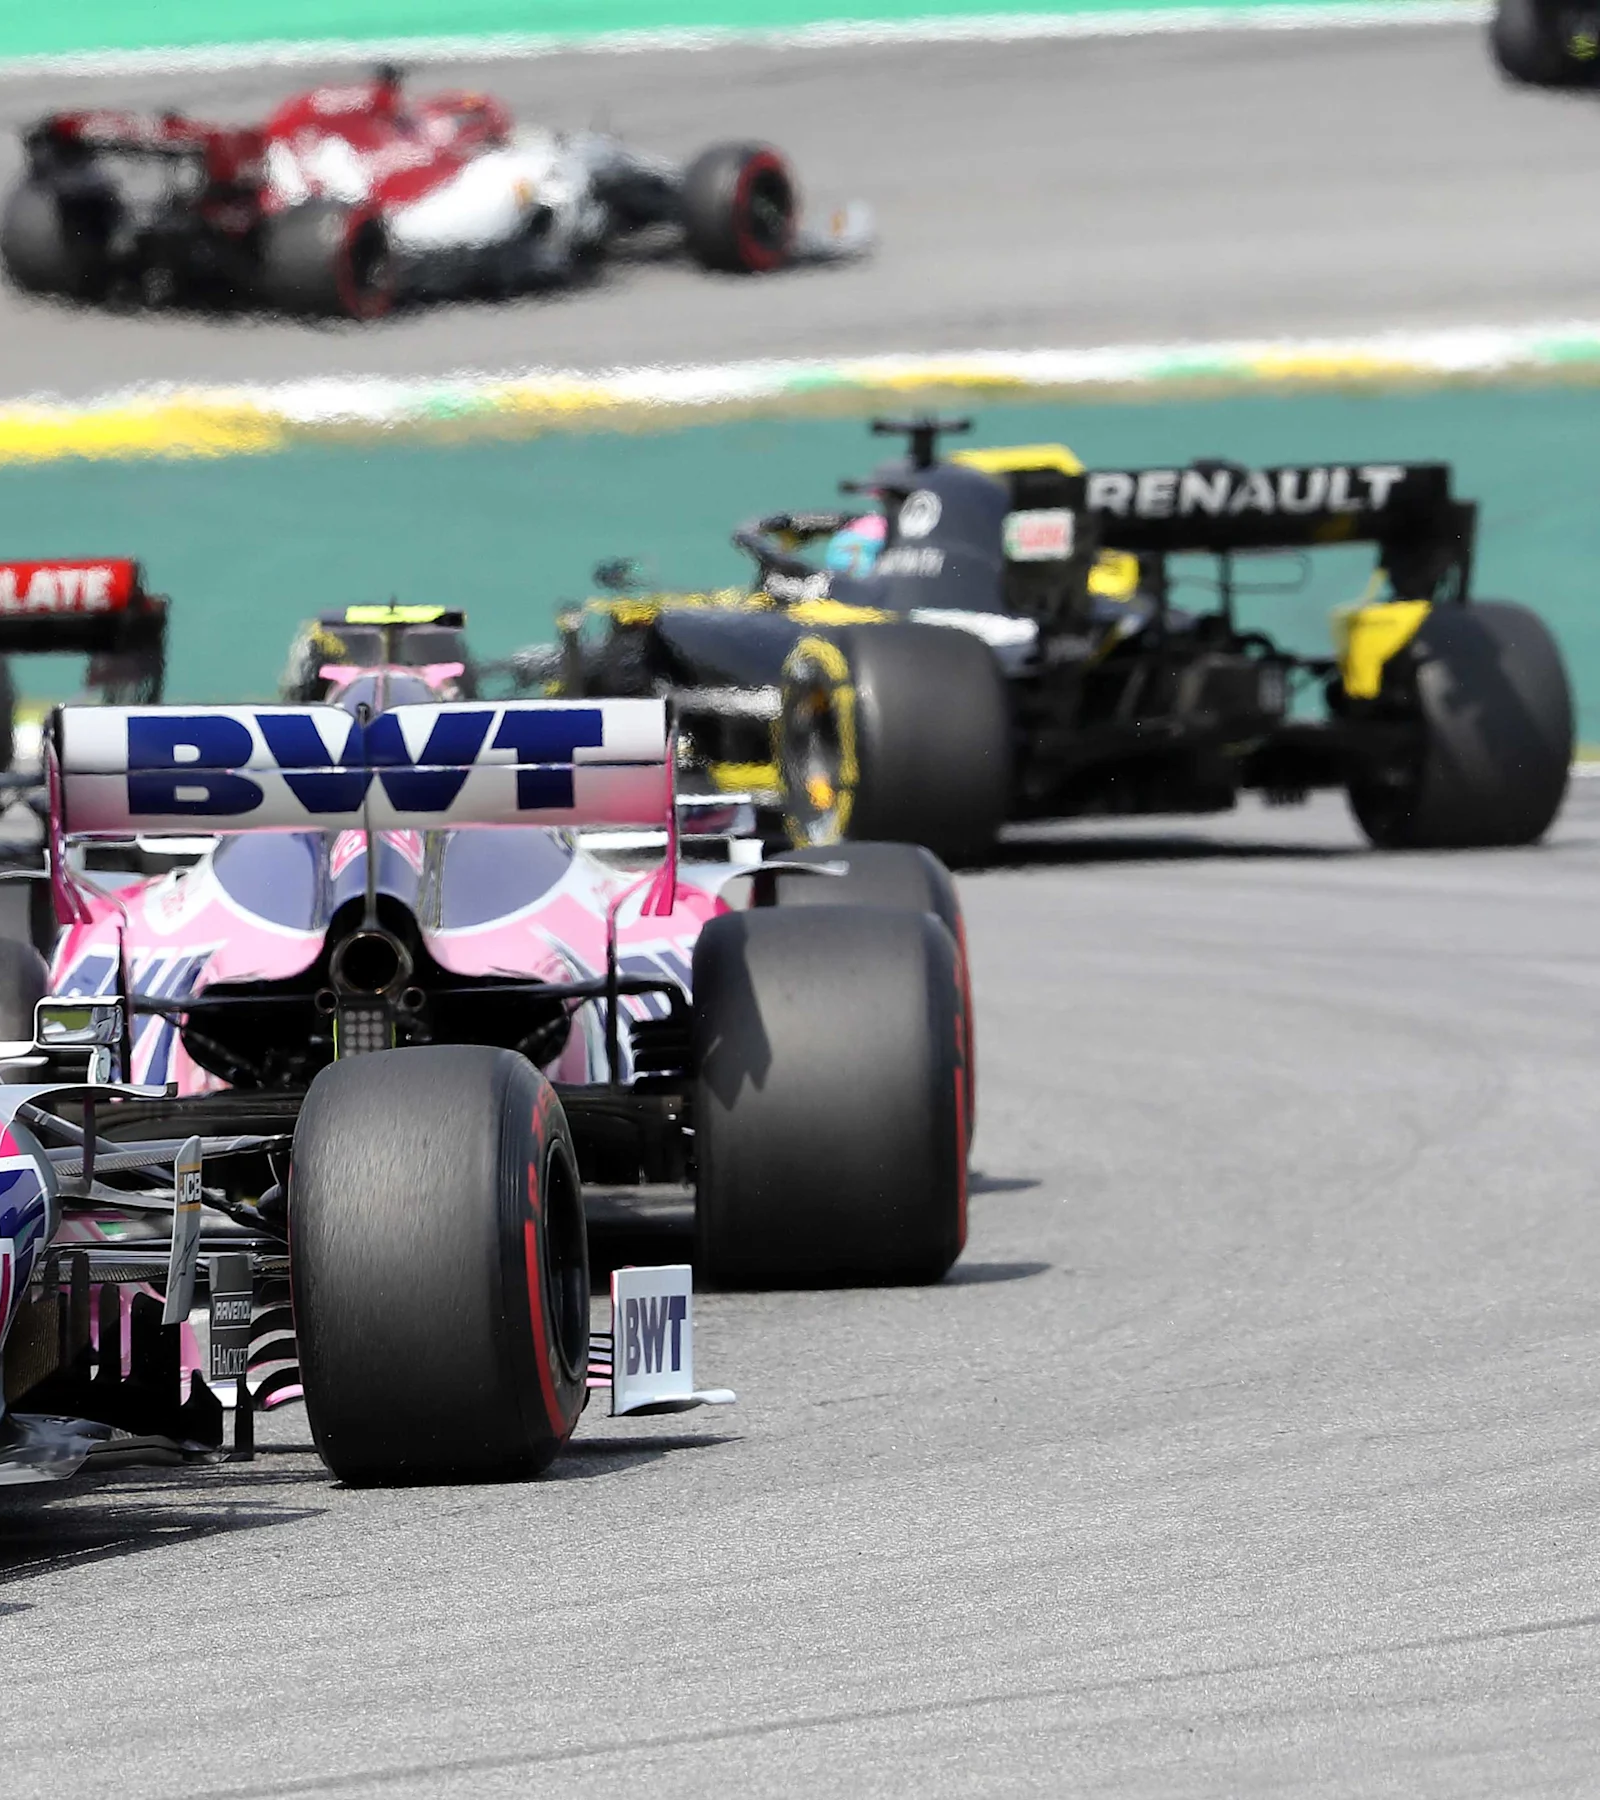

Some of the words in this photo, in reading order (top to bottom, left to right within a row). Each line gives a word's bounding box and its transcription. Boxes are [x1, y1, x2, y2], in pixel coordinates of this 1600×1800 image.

[1086, 465, 1406, 517] RENAULT
[127, 709, 604, 816] BWT
[179, 1171, 202, 1203] JCB
[625, 1295, 687, 1377] BWT
